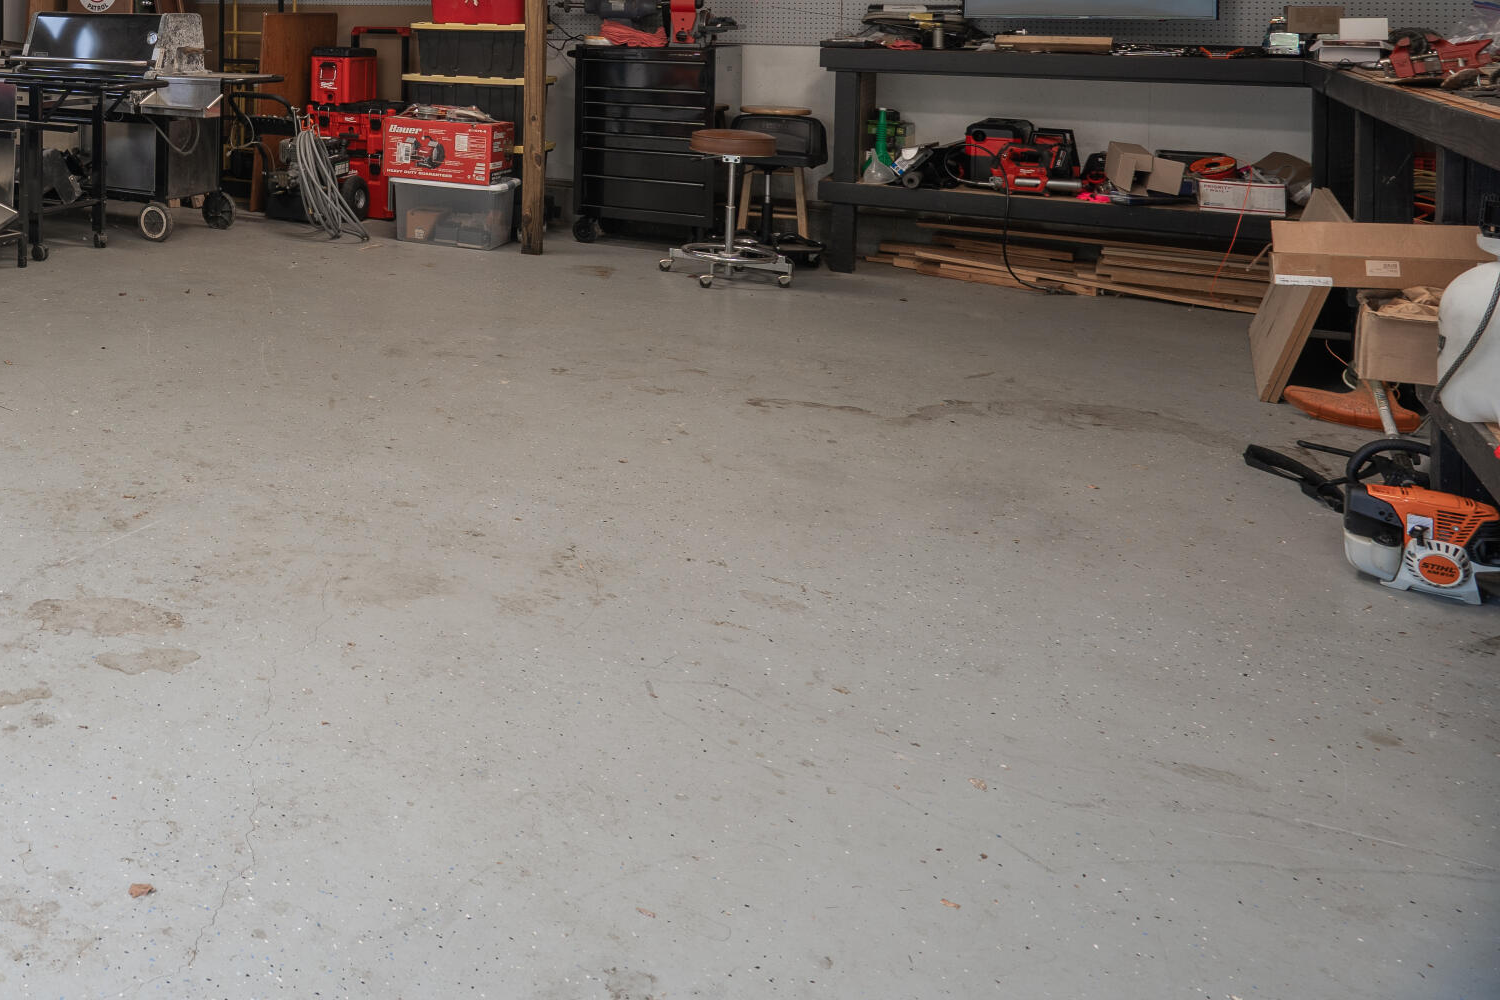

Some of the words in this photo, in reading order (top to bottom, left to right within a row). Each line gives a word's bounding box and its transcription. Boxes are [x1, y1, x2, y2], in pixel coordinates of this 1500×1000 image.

[87, 3, 109, 11] PATROL
[388, 124, 422, 135] Bauer
[1421, 562, 1457, 574] STIHL
